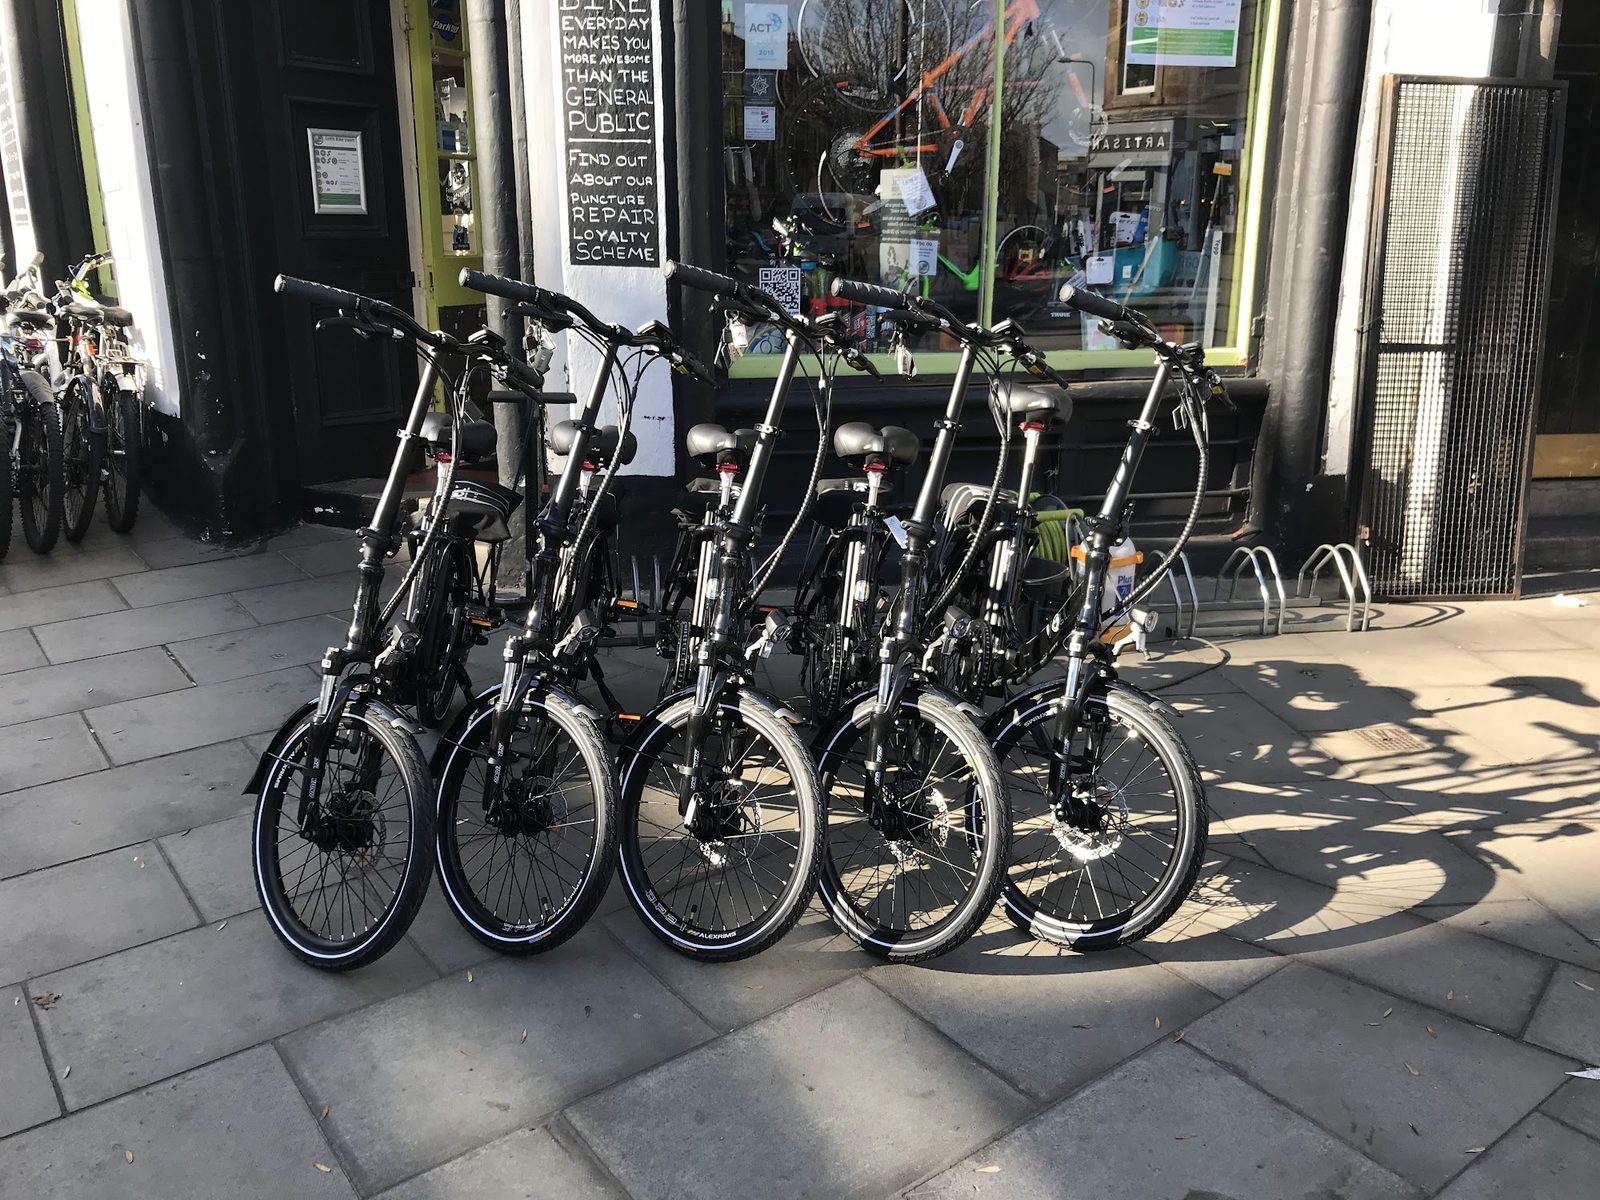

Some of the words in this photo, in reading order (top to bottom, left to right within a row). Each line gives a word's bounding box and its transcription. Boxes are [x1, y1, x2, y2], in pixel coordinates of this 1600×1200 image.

[562, 15, 650, 31] EVERYDAY
[749, 23, 772, 33] ACT
[563, 34, 620, 51] MAKES
[623, 36, 650, 51] YOU
[563, 53, 597, 64] MORE
[600, 54, 651, 65] AWESOME
[565, 68, 612, 83] THAN
[617, 69, 649, 83] THE
[565, 86, 654, 107] GENERAL
[568, 110, 650, 134] PUBLIC
[569, 149, 611, 167] FIND
[615, 155, 648, 167] OUT
[570, 172, 622, 187] ABOUT
[626, 176, 653, 187] OUR
[570, 192, 646, 205] PUNCTURE
[572, 206, 655, 225] REPAIR
[573, 227, 650, 244] LOYALTY
[575, 242, 655, 262] SCHEME
[1213, 239, 1222, 256] Yepp
[1117, 575, 1133, 585] Plus
[698, 930, 737, 940] ALEXRIMS
